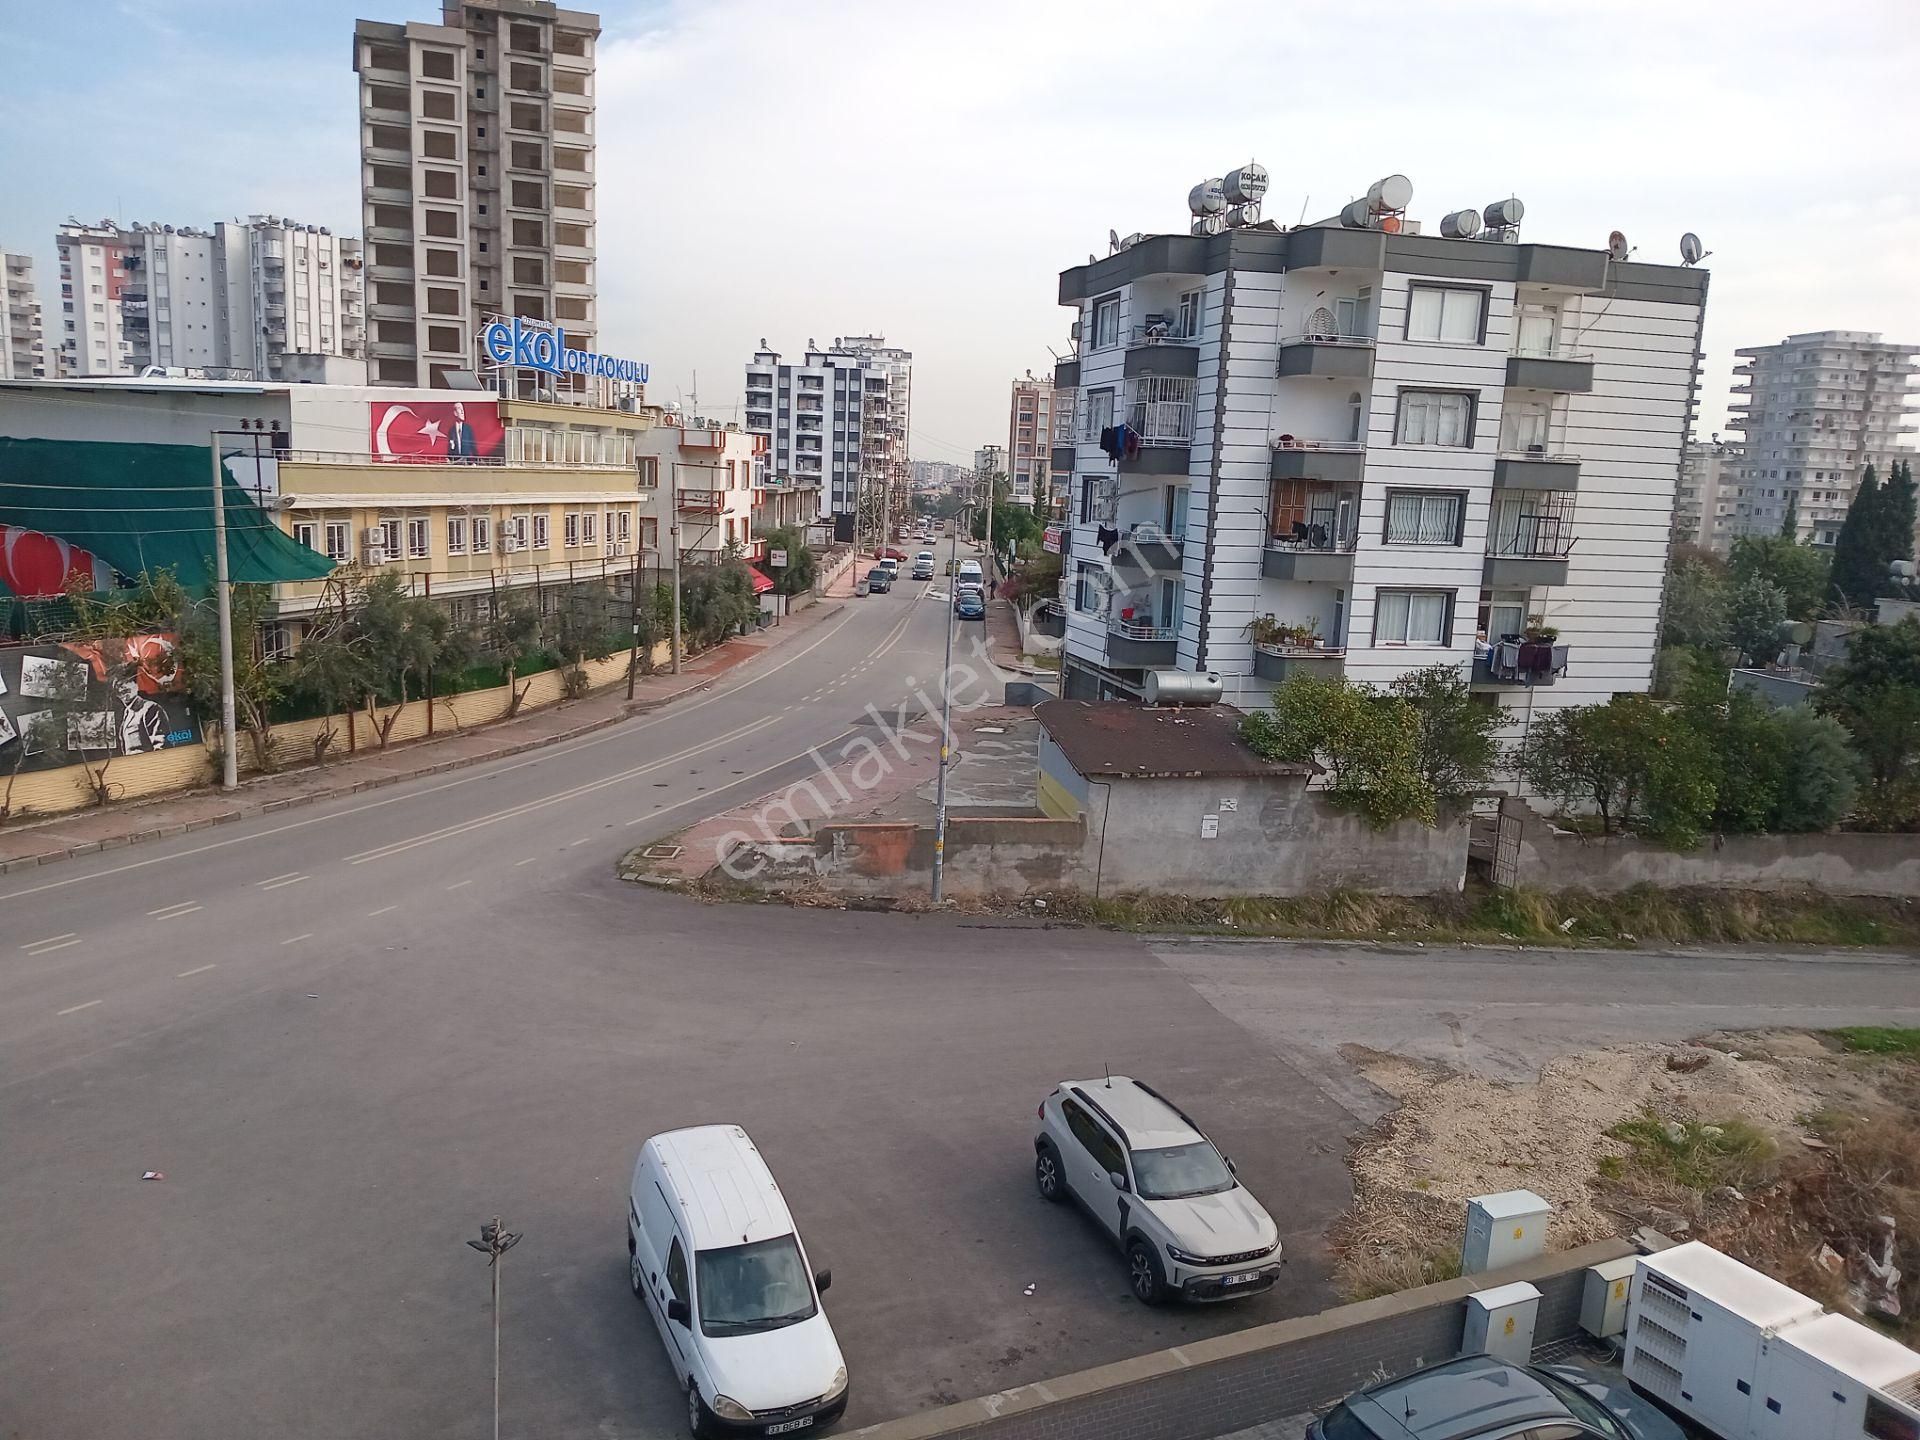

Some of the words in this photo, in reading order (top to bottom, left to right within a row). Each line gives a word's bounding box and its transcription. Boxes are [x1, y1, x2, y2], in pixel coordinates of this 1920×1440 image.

[485, 317, 565, 376] ekol
[566, 350, 649, 384] ORTAOKULU
[167, 729, 192, 742] ekol
